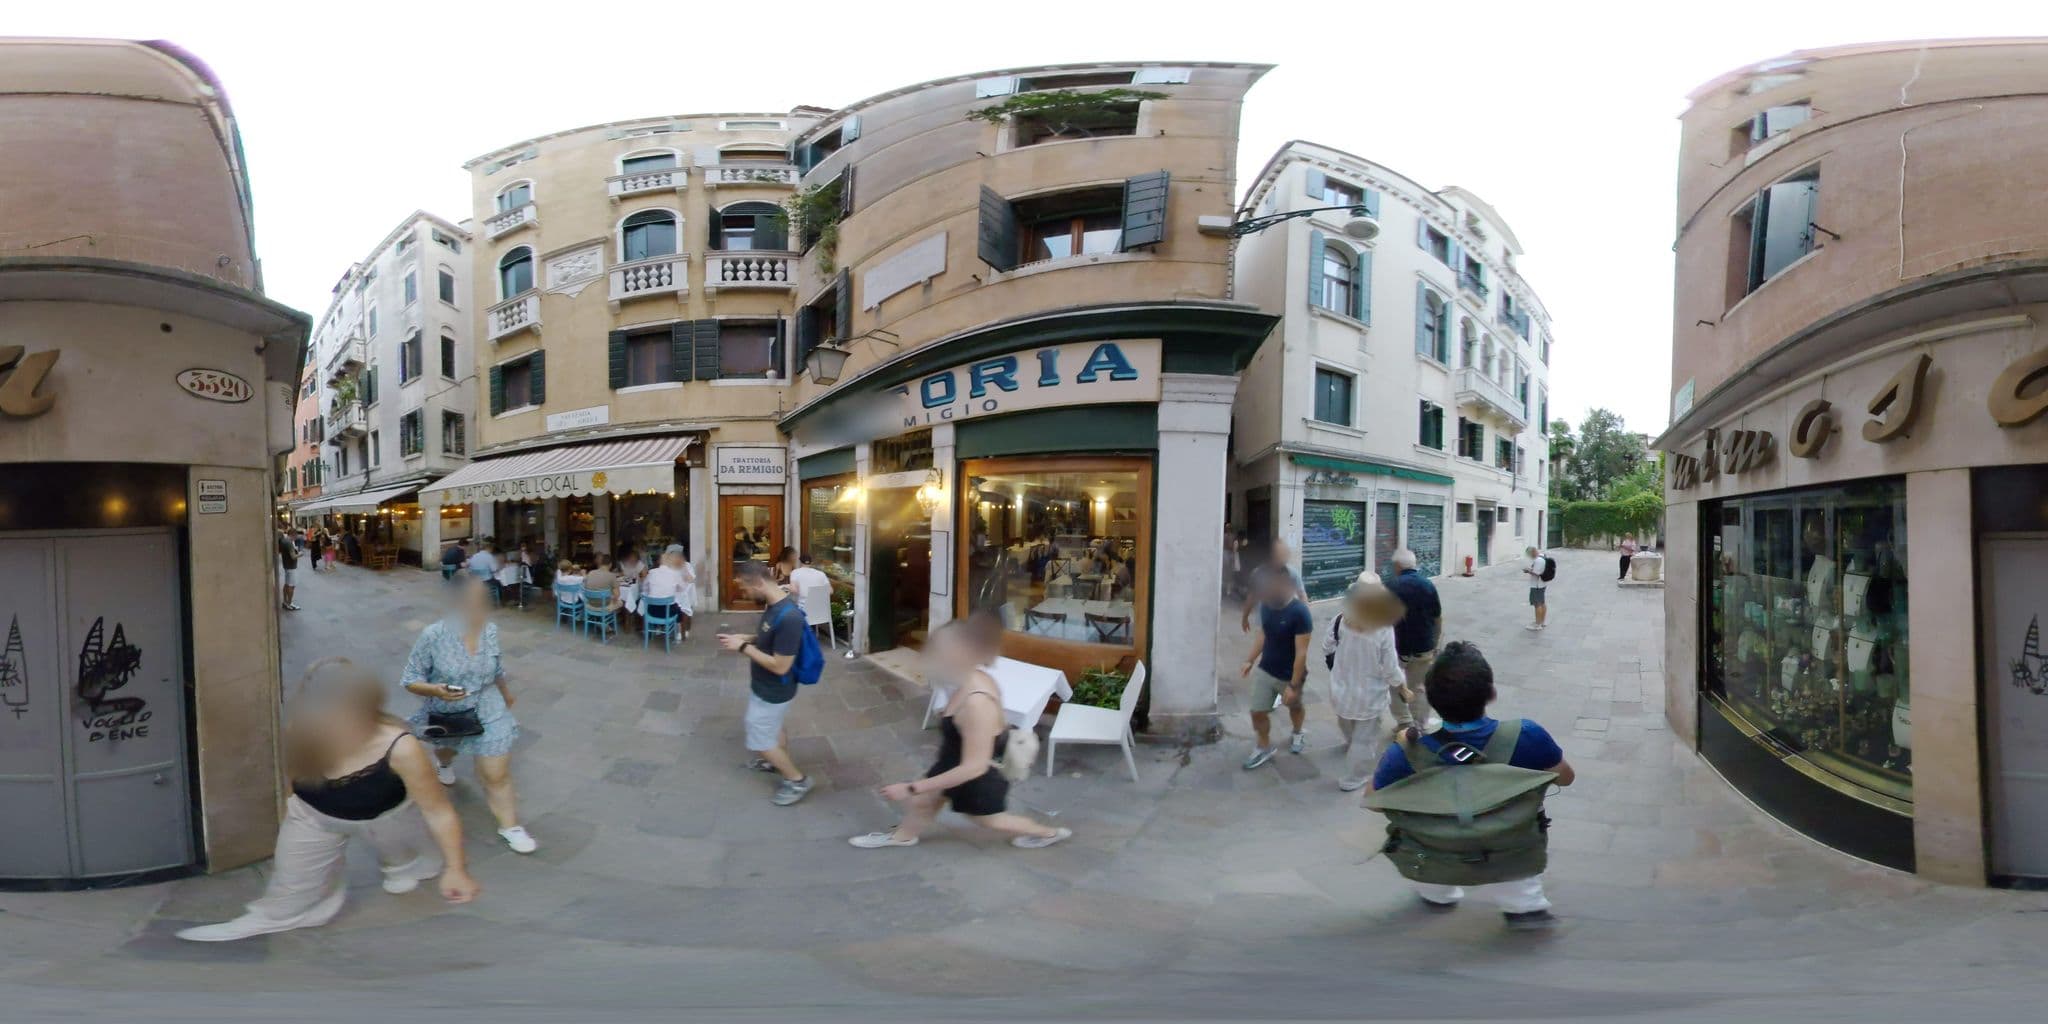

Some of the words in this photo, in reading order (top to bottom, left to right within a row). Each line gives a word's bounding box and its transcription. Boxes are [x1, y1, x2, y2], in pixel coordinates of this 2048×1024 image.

[893, 342, 1138, 410] ORIA
[903, 399, 998, 428] MIGIO
[720, 465, 736, 474] DA
[738, 465, 783, 474] REMIGIO
[457, 482, 507, 499] TRATTORIA
[512, 480, 531, 496] DEL
[535, 475, 579, 493] LOCAL
[88, 726, 149, 742] BENE
